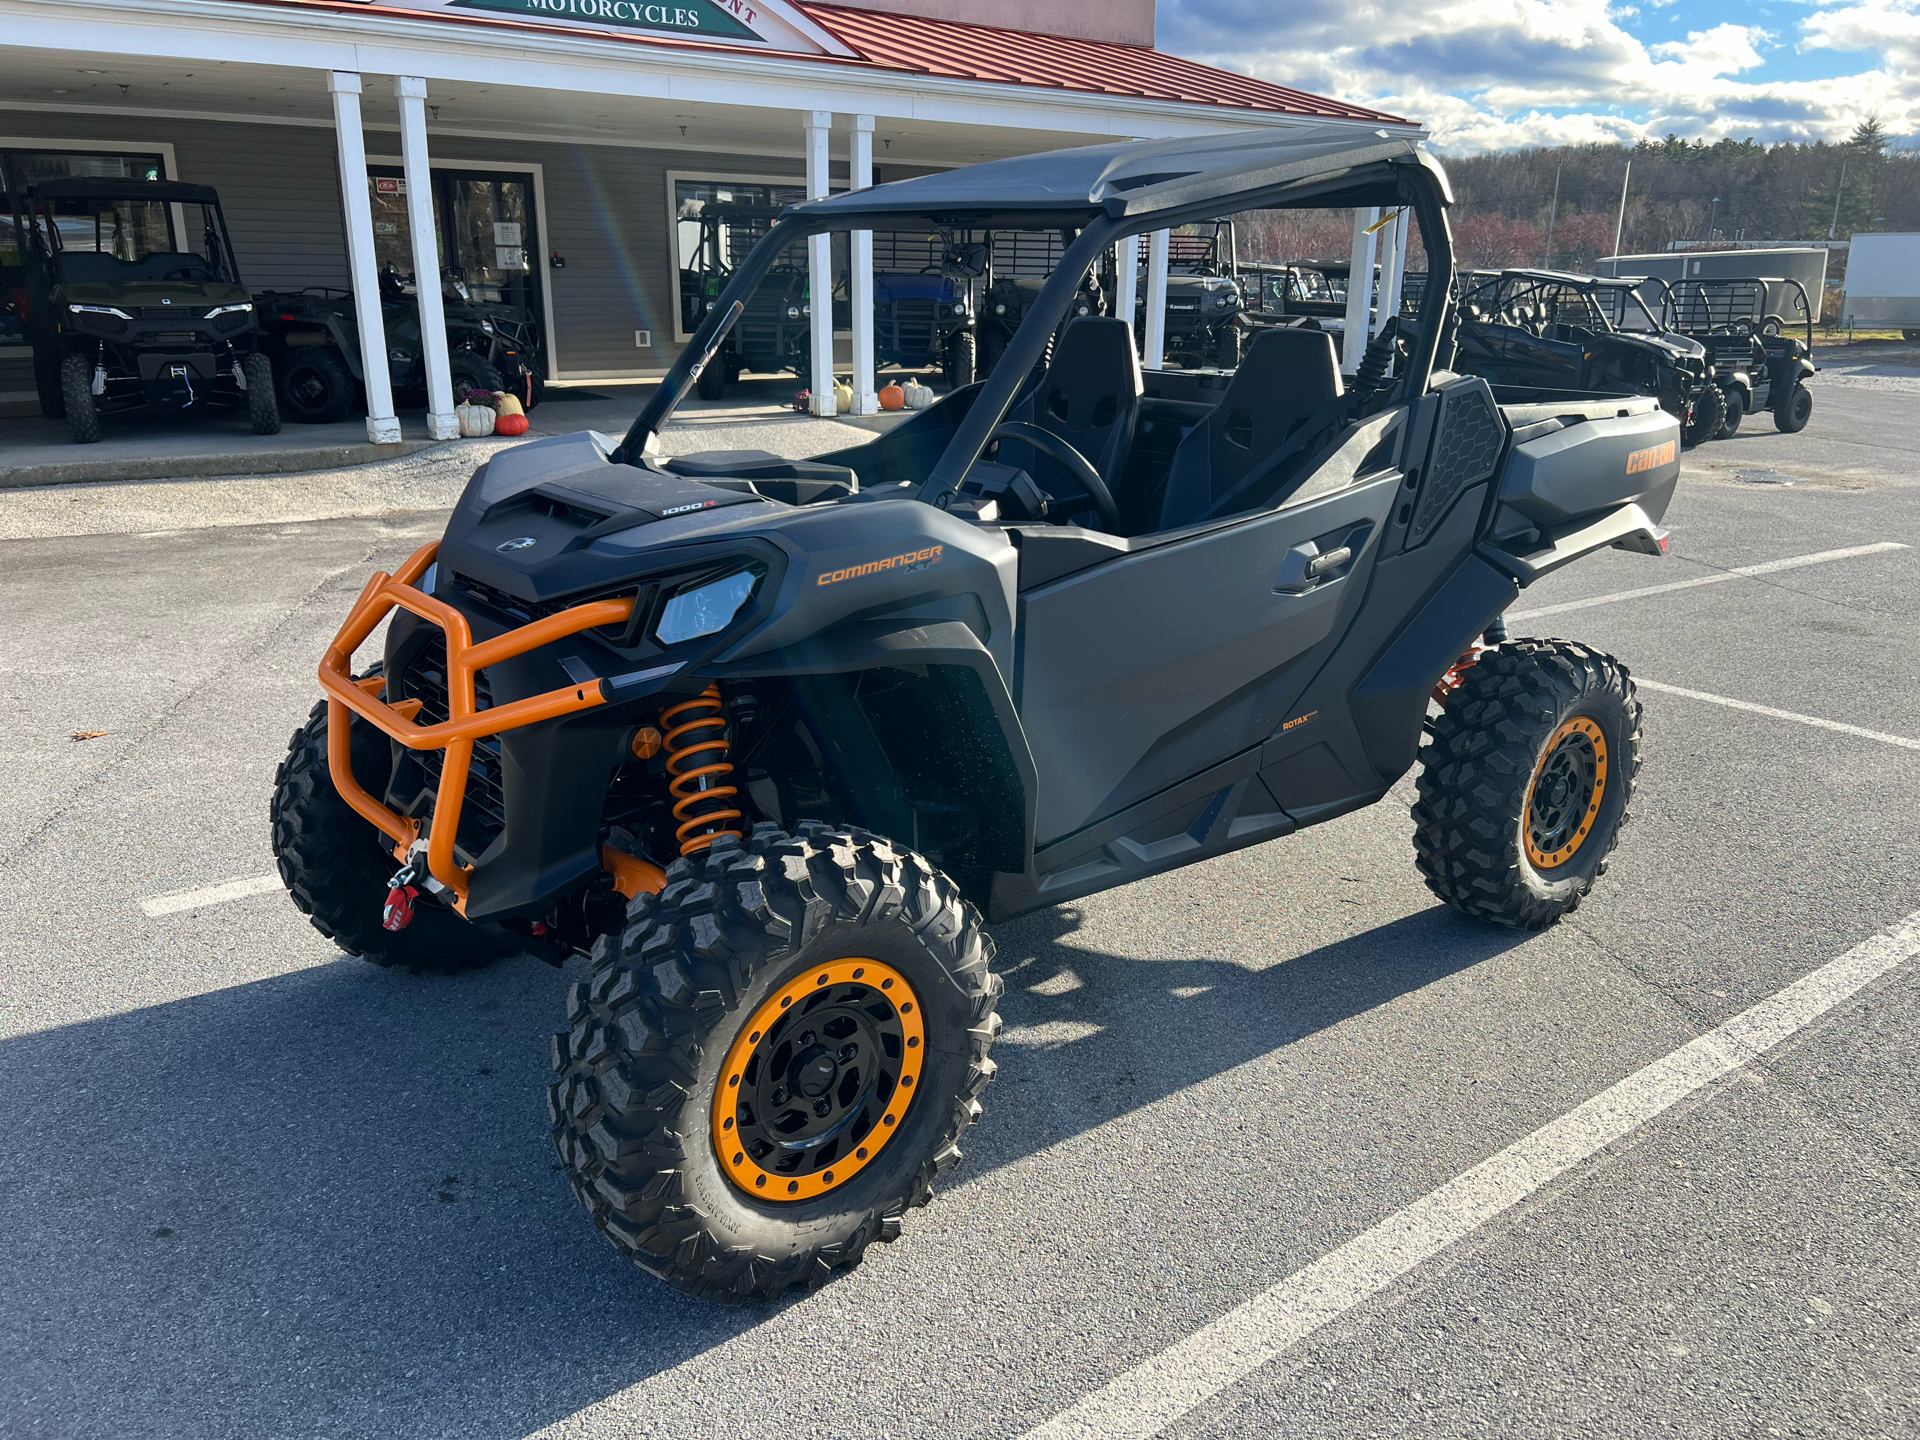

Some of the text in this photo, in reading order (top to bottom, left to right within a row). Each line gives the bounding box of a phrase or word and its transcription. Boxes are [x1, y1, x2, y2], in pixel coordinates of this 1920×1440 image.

[526, 0, 699, 27] MOTORCYCLES
[662, 500, 716, 516] 1000R
[817, 545, 943, 586] COMMANDER
[1282, 714, 1308, 731] ROTAX
